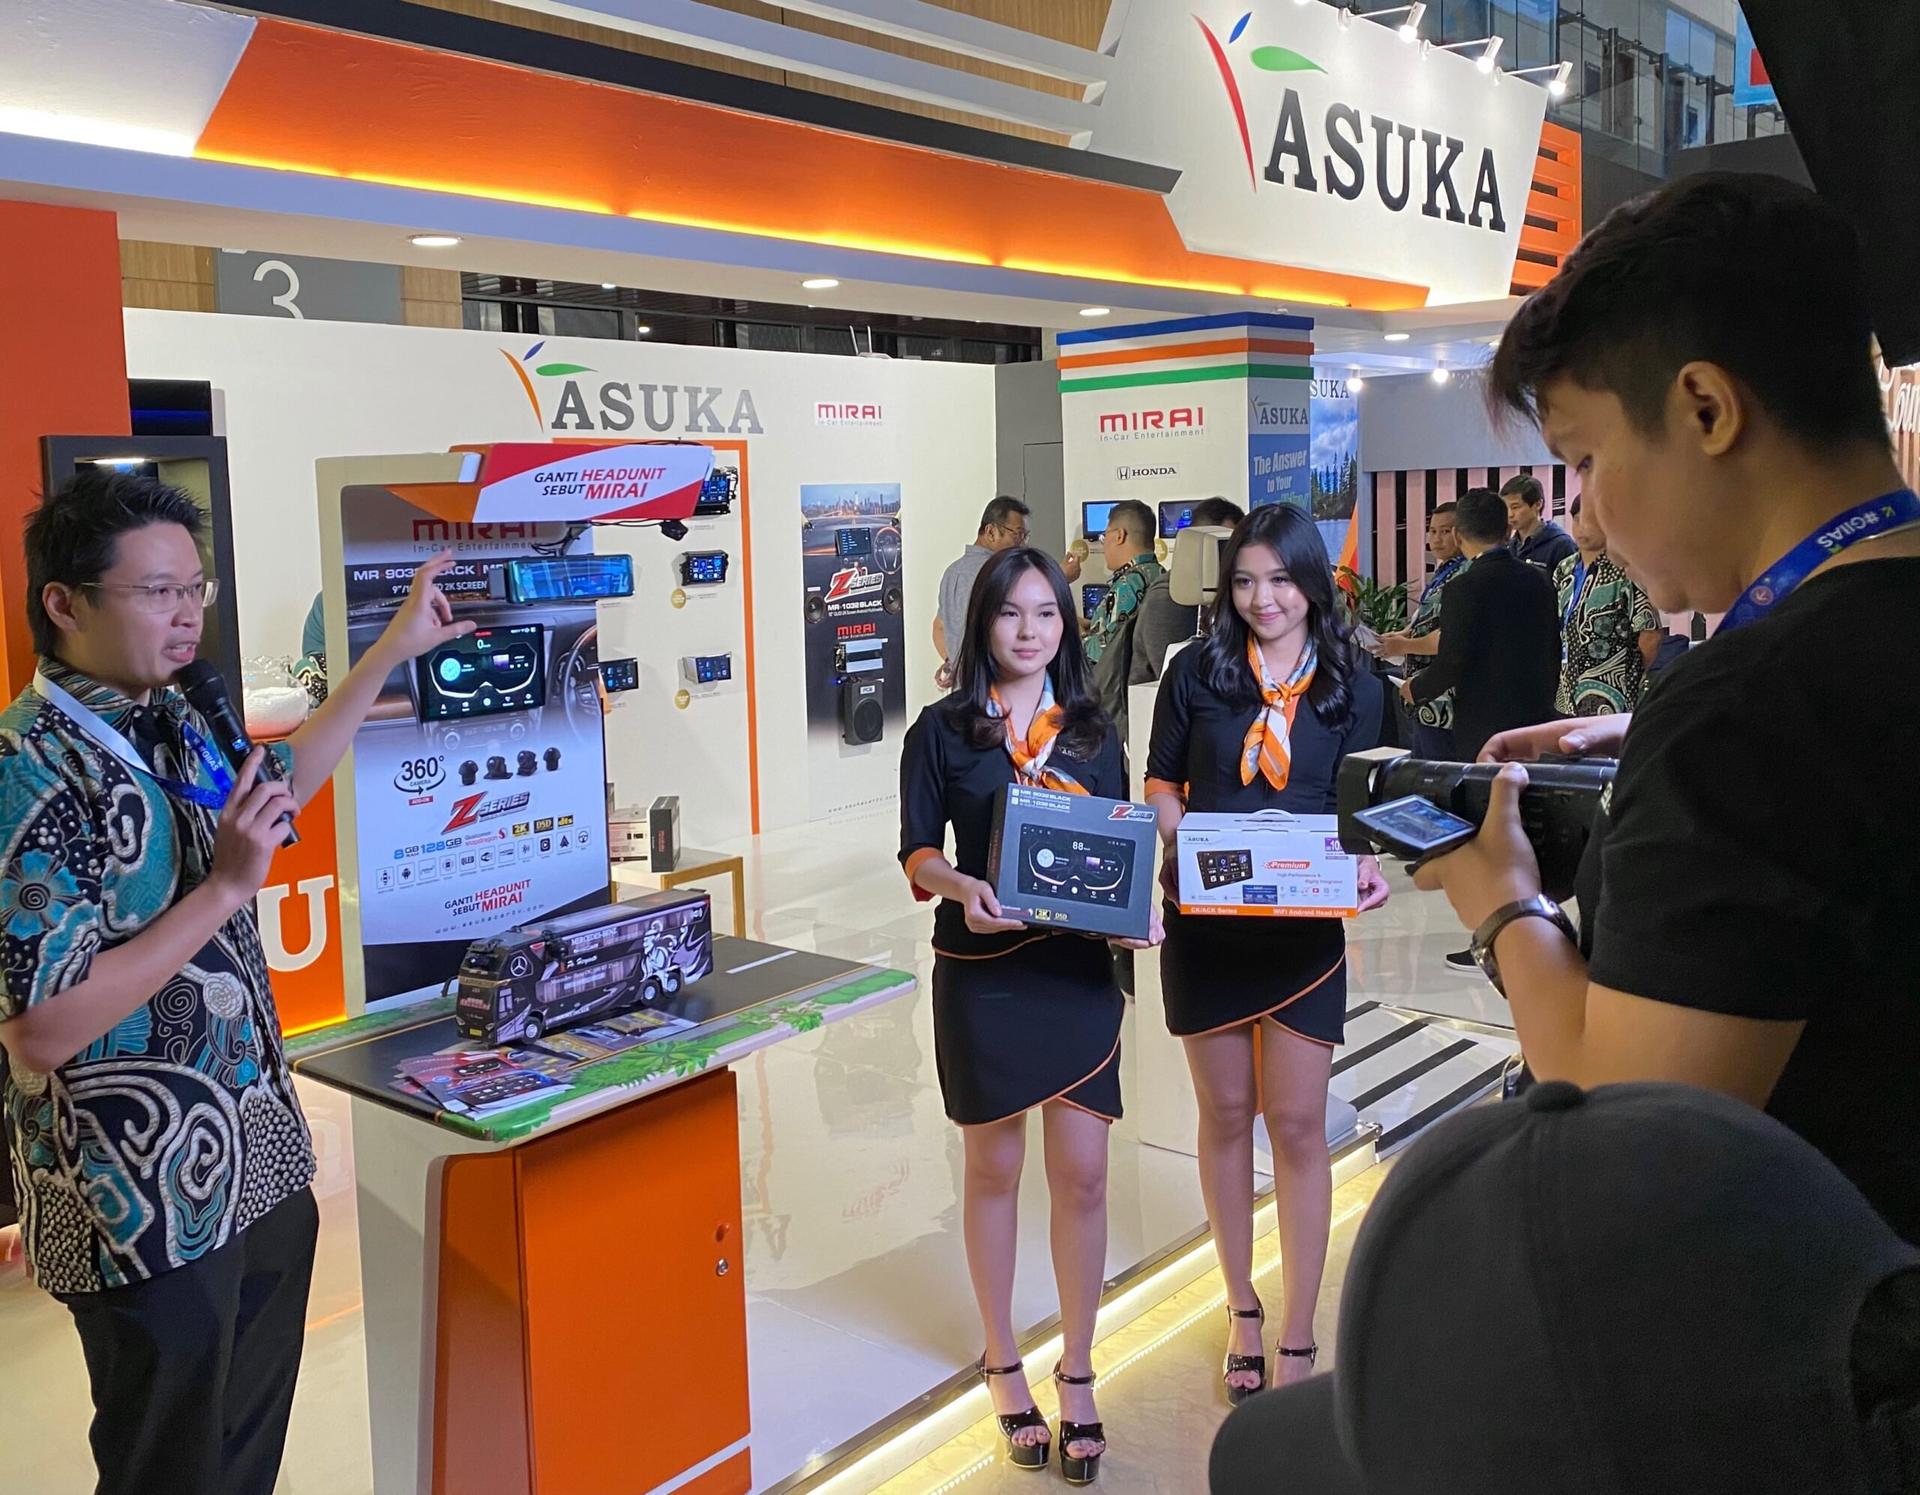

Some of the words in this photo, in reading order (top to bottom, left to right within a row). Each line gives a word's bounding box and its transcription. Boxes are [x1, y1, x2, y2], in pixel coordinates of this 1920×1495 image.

[1264, 88, 1506, 233] ASUKA
[1310, 378, 1349, 398] SUKA
[551, 380, 764, 435] ASUKA
[818, 404, 882, 419] MIRAI
[1260, 408, 1308, 425] ASUKA
[1100, 406, 1204, 433] MIRAI
[1100, 433, 1130, 441] In-Car
[1135, 429, 1204, 440] Entertainment
[1132, 467, 1177, 477] HONDA
[1253, 455, 1271, 477] The
[1272, 450, 1308, 473] Answer
[534, 472, 578, 483] GANTI
[580, 467, 666, 482] HEADUNIT
[1267, 479, 1275, 493] to
[1275, 475, 1293, 491] Your
[542, 484, 586, 496] SEBUT
[584, 482, 648, 500] MIRAI
[457, 580, 487, 591] SCREEN
[850, 574, 882, 588] SERIES
[860, 600, 883, 608] BLACK
[838, 624, 876, 635] MIRAI
[479, 792, 530, 815] SERIES
[394, 848, 404, 859] 8
[405, 845, 419, 854] GB
[421, 841, 445, 854] 128
[446, 837, 462, 847] GB
[444, 895, 473, 910] GANTI
[475, 879, 532, 902] HEADUNIT
[452, 903, 480, 917] SEBUT
[481, 892, 523, 913] MIRAI
